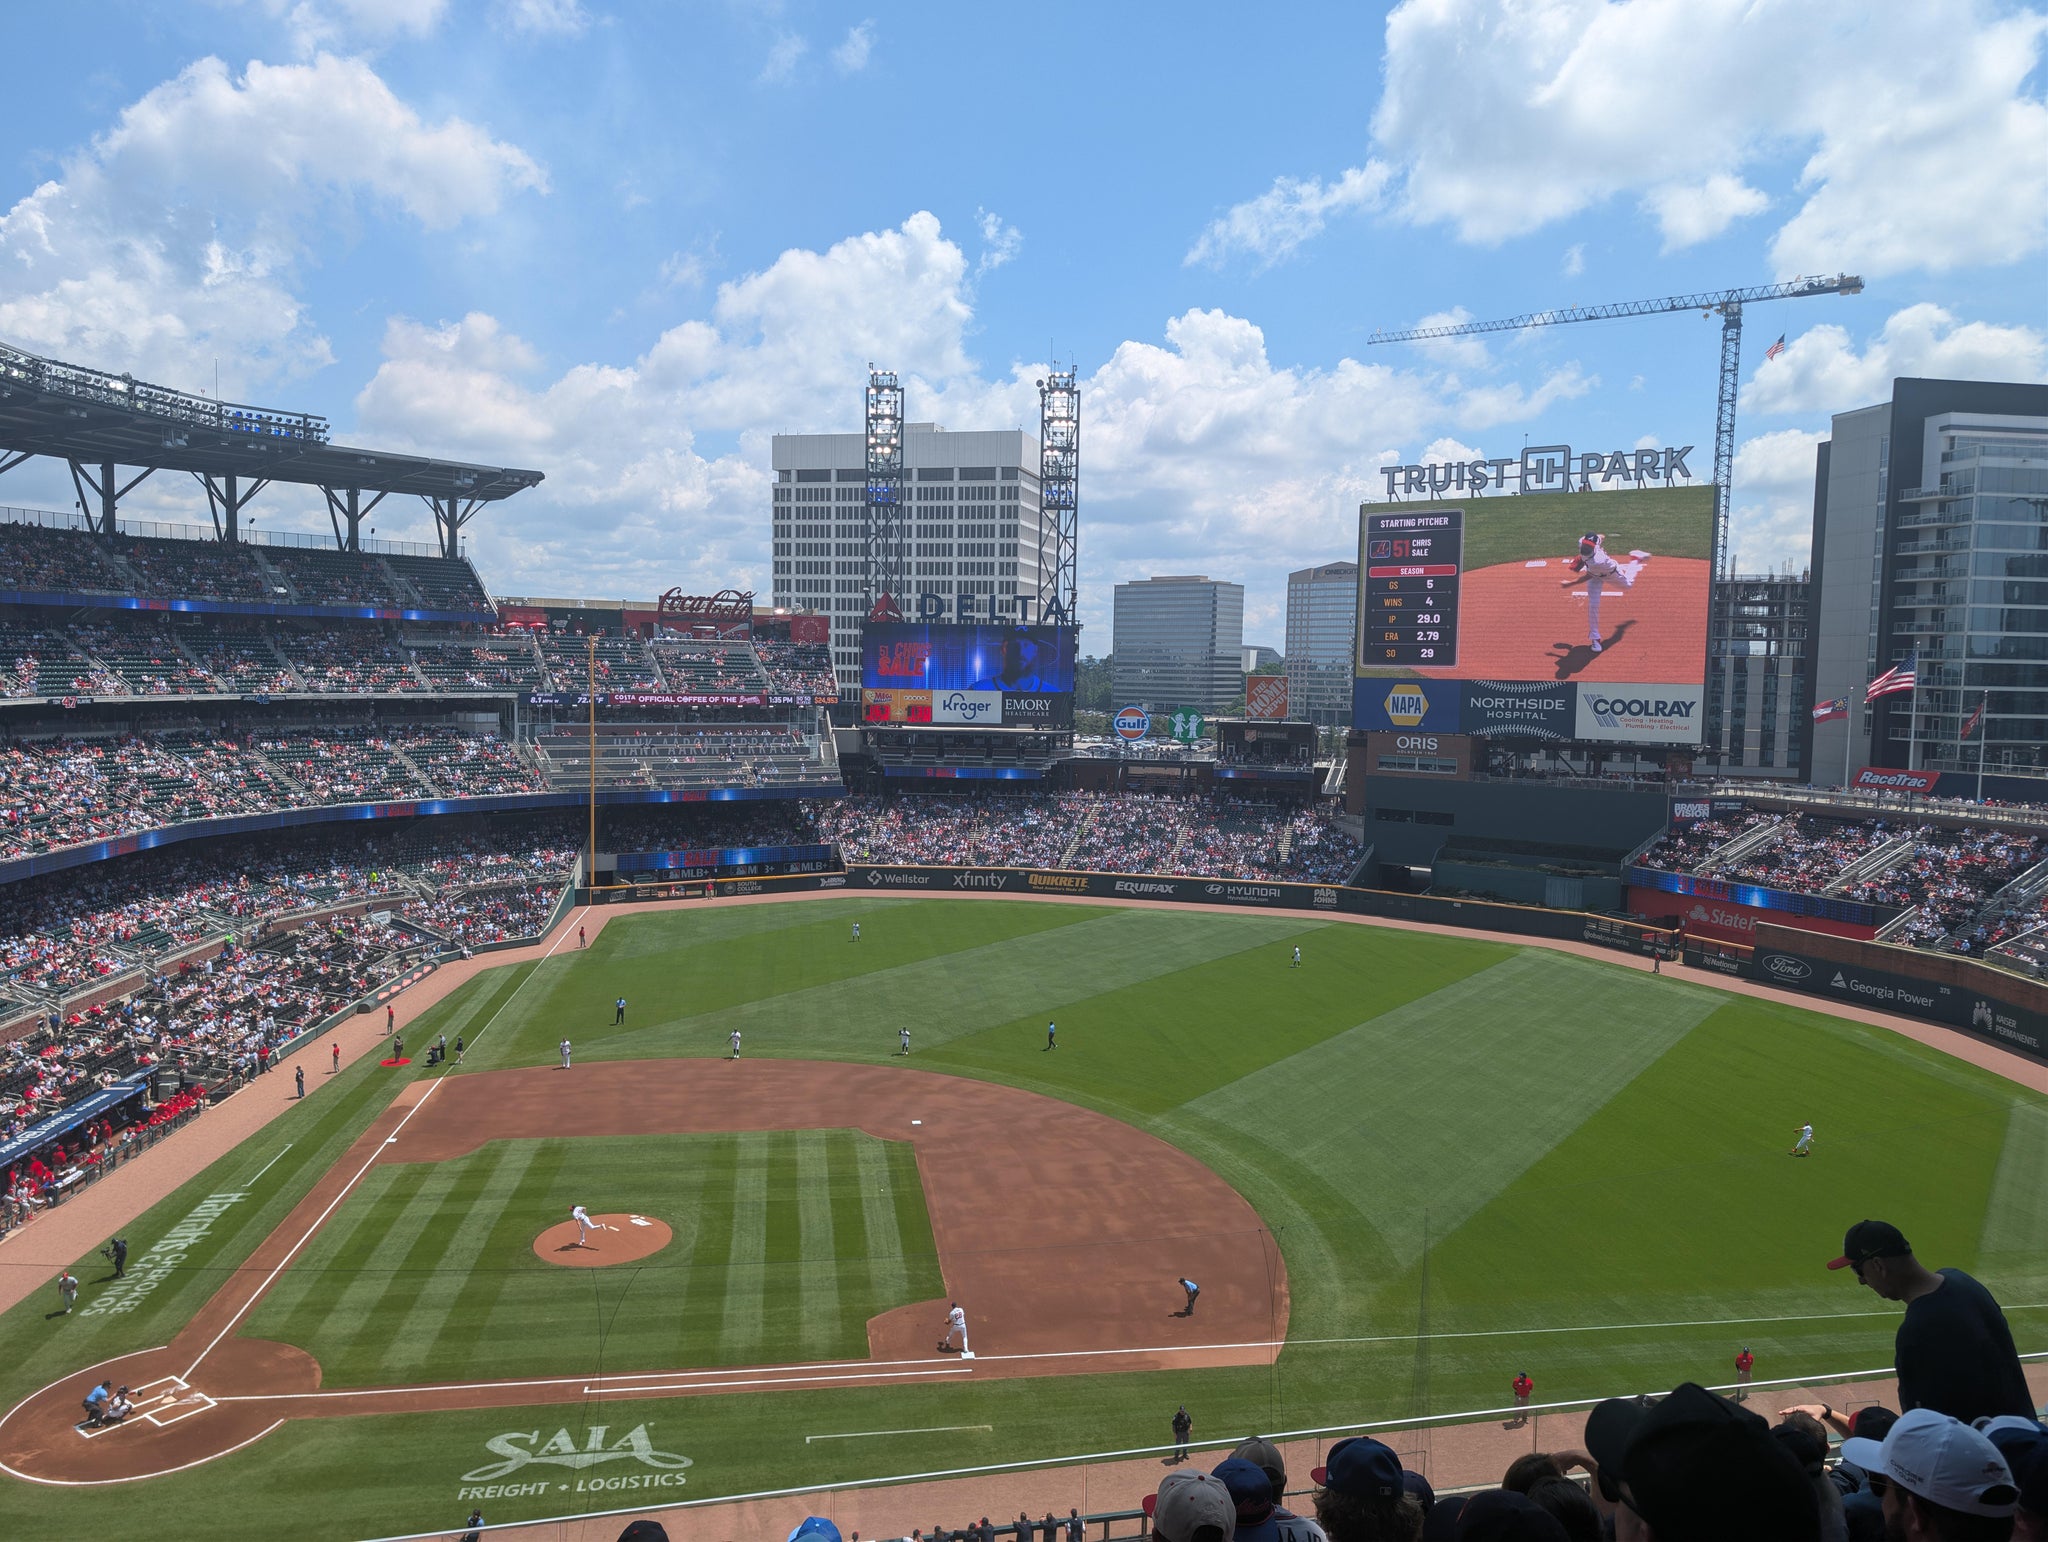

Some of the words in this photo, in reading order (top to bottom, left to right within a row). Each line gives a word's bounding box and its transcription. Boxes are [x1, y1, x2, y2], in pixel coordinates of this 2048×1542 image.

[1380, 458, 1513, 495] TRUIST
[1581, 446, 1695, 484] PARK
[1380, 518, 1416, 528] STARTING
[1417, 517, 1449, 526] PITCHER
[1392, 539, 1411, 558] 51
[1412, 539, 1432, 547] CHRIS
[1412, 548, 1429, 556] SALE
[1388, 581, 1399, 590] GS
[1426, 580, 1434, 589] 5
[1384, 598, 1402, 607] WINS
[1425, 596, 1434, 606] 4
[920, 594, 1068, 625] DELTA
[1388, 615, 1397, 624] IP
[1417, 614, 1441, 624] 29.0
[1384, 632, 1399, 641] ERA
[1416, 631, 1440, 641] 2.79
[1386, 649, 1396, 658] SO
[1420, 648, 1434, 658] 29
[878, 656, 926, 676] SALE
[1252, 680, 1268, 696] THE
[782, 696, 793, 704] PM
[1247, 678, 1288, 716] HOME
[942, 692, 992, 720] Kroger
[1006, 699, 1052, 711] EMORY
[1262, 691, 1288, 717] DEPOT
[1392, 696, 1422, 714] NAPA
[1470, 697, 1566, 710] NORTHSIDE
[1592, 699, 1697, 718] COOLRAY
[1486, 710, 1548, 720] HOSPITAL
[1116, 718, 1148, 729] Gulf
[1396, 736, 1438, 750] ORIS
[1858, 770, 1928, 788] RaceTrac
[681, 868, 710, 878] MLB+
[801, 862, 828, 872] MLB+
[884, 873, 930, 884] Wellstar
[952, 870, 1008, 889] xfinity
[1028, 874, 1088, 887] QUIKRETE
[1114, 881, 1175, 894] EQUIFAX
[1228, 886, 1280, 897] HYUNDAI
[1314, 888, 1336, 897] PAPA
[1770, 958, 1802, 976] Ford
[1850, 980, 1894, 999] Georgia
[1898, 989, 1934, 1007] Power
[1996, 1014, 2016, 1029] KAISER
[1995, 1024, 2038, 1048] PERMANENTE
[460, 1422, 694, 1482] SAIA
[457, 1482, 550, 1500] FREIGHT
[577, 1473, 686, 1492] LOGISTICS
